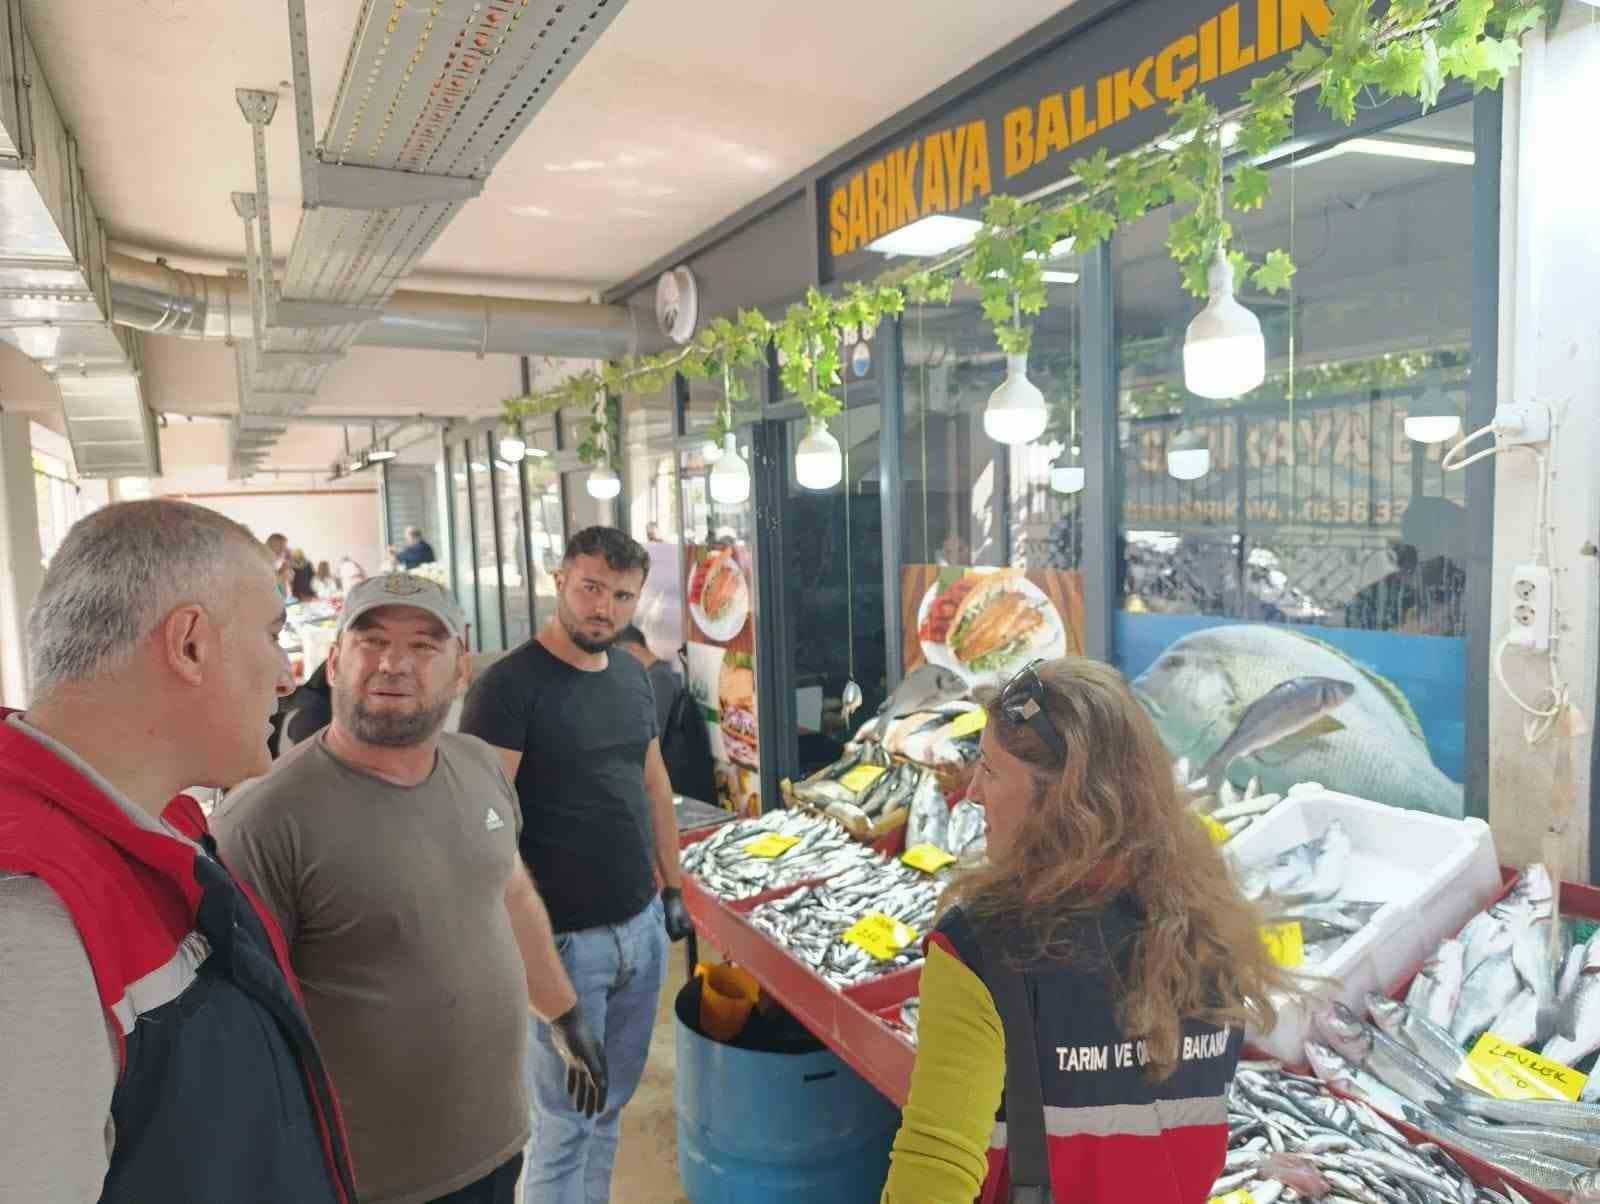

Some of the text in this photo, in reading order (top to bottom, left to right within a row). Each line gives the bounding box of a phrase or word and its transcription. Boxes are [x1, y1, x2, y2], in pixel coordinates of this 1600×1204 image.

[829, 119, 991, 257] SARIKAYA
[1056, 1045, 1107, 1071] TARIM
[1114, 1042, 1133, 1067] VE
